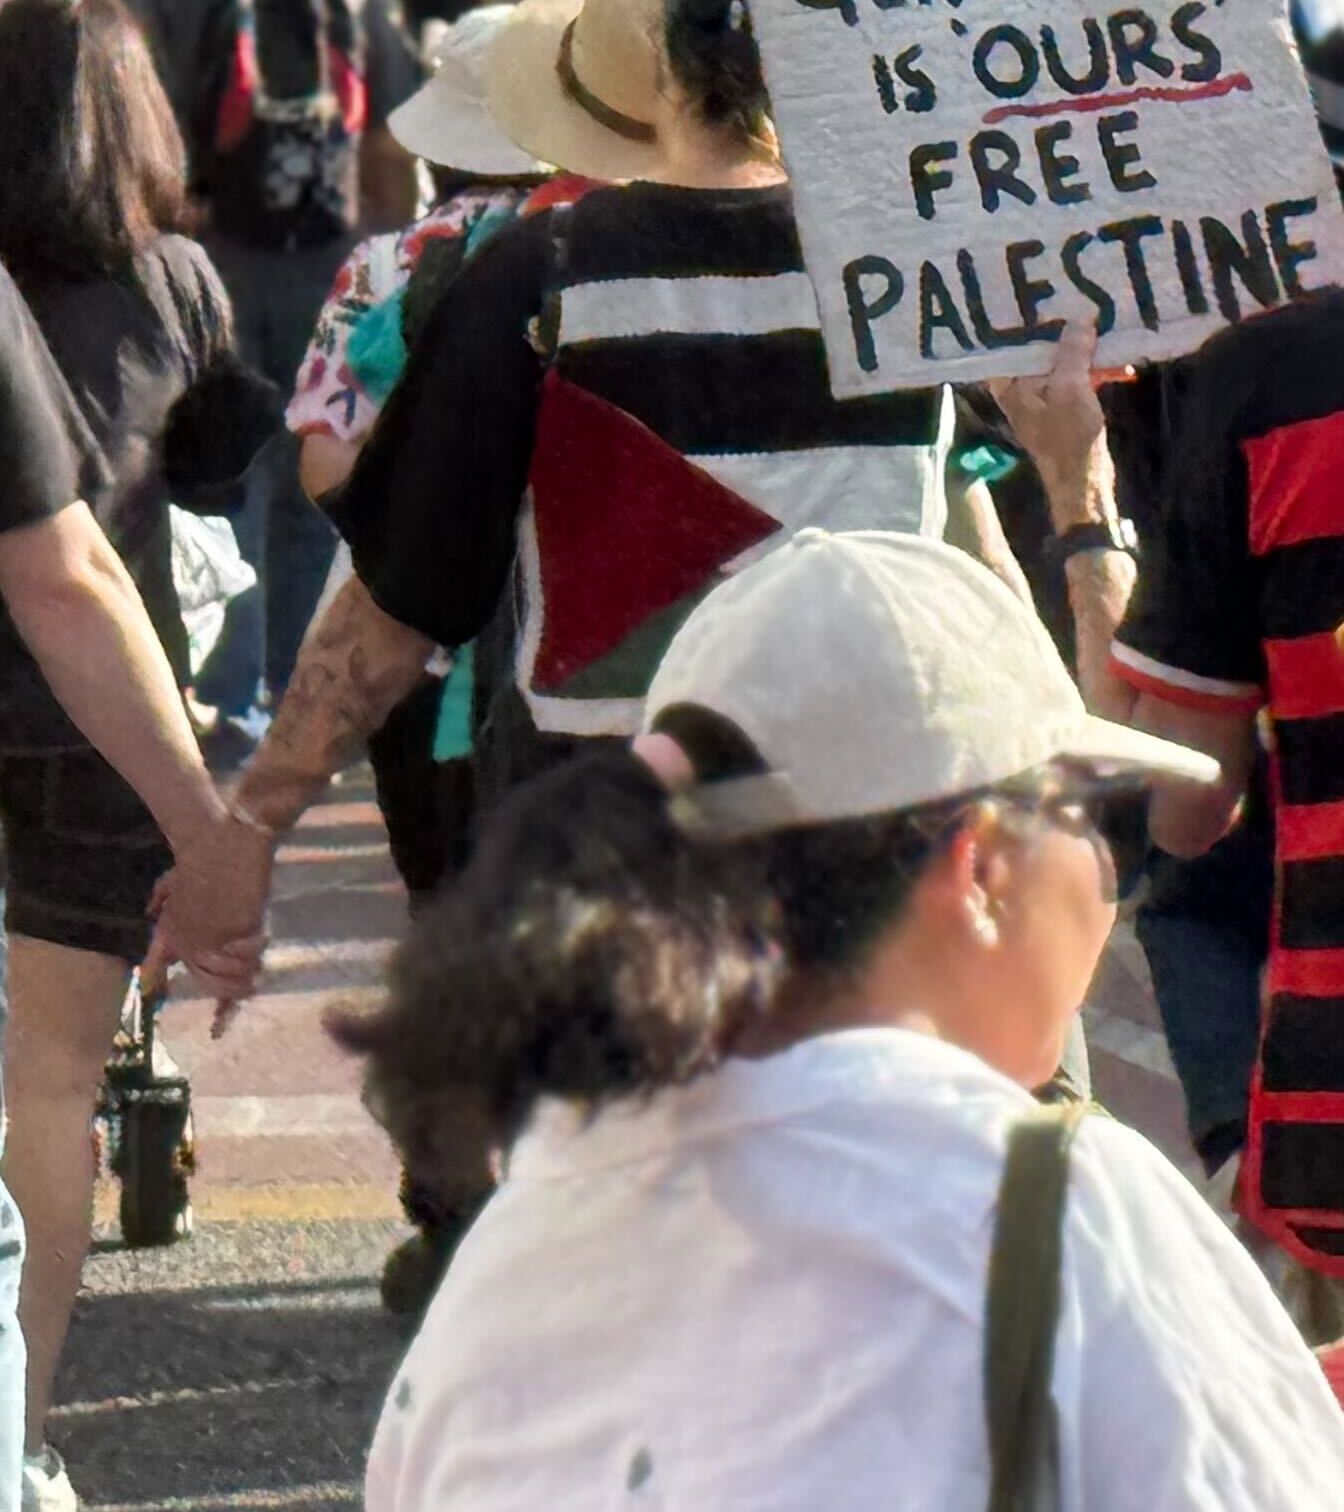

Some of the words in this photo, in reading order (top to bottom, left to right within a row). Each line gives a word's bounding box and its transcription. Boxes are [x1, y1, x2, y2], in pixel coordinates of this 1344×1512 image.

[872, 43, 937, 115] IS
[909, 110, 1158, 221] FREE
[842, 196, 1319, 373] PALESTINE
